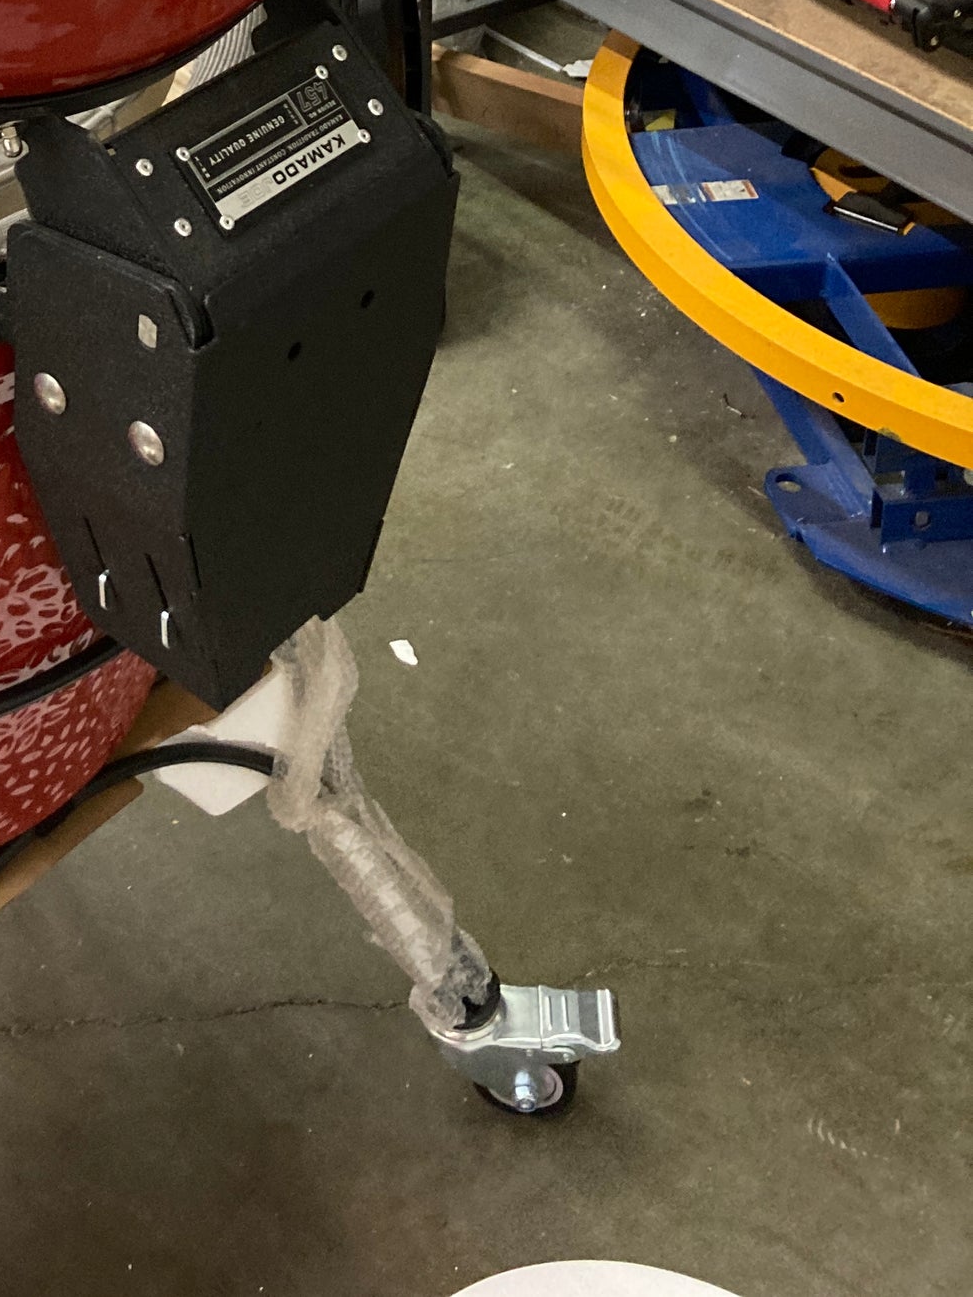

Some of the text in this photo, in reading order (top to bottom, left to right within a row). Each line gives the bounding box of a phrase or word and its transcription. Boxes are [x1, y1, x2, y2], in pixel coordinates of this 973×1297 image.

[296, 81, 328, 113] 457
[208, 115, 285, 166] GENUINE QUALITY
[238, 133, 346, 208] KAMADO JOE
